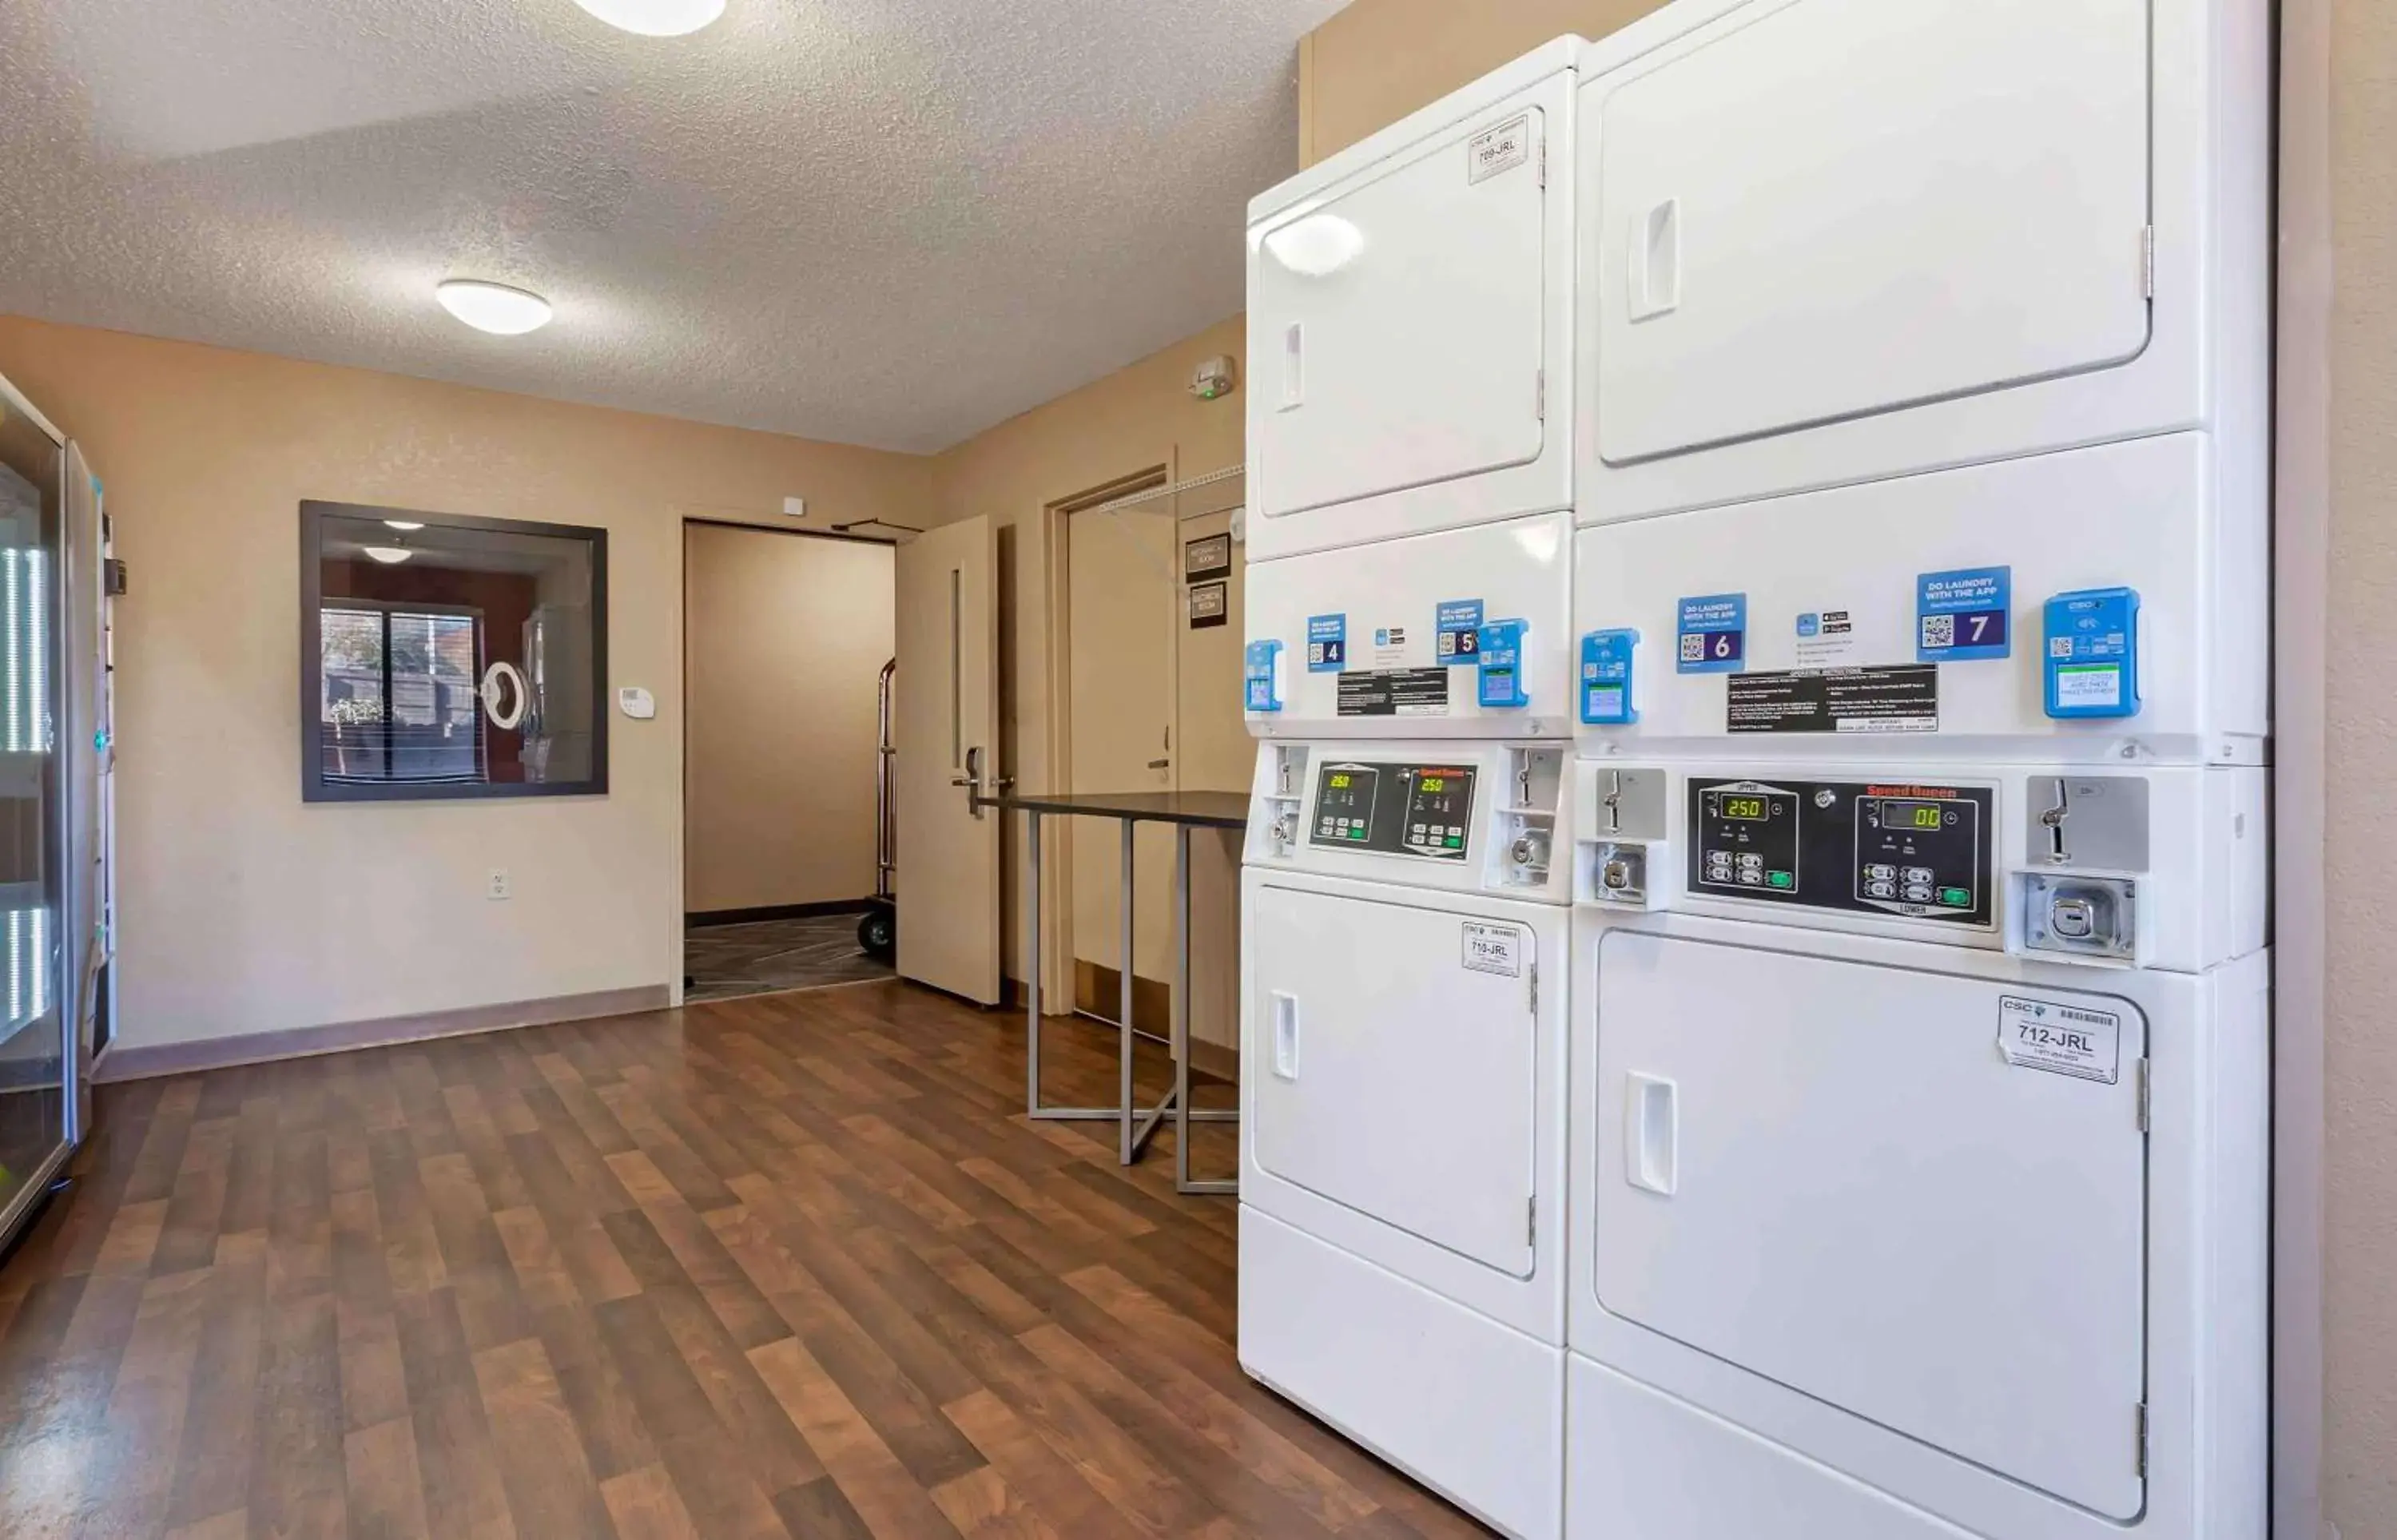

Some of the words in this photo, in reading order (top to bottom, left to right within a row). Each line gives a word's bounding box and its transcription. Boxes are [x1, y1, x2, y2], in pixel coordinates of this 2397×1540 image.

[1928, 582, 1943, 591] DO
[1946, 578, 1994, 589] LAUNDRY
[1925, 591, 1952, 601] WITH
[1954, 589, 1974, 598] THE
[1976, 586, 1998, 595] APP
[1970, 616, 1989, 641] 7
[1462, 633, 1473, 652] 5
[1715, 635, 1730, 657] 6
[1328, 644, 1338, 661] 4
[1867, 785, 1910, 796] Speed
[1912, 787, 1956, 798] Queen
[1728, 800, 1759, 816] 250
[1915, 808, 1939, 827] 00
[1899, 903, 1926, 915] LOWER
[2004, 1001, 2032, 1012] CSC
[2019, 1025, 2093, 1052] 712-JRL
